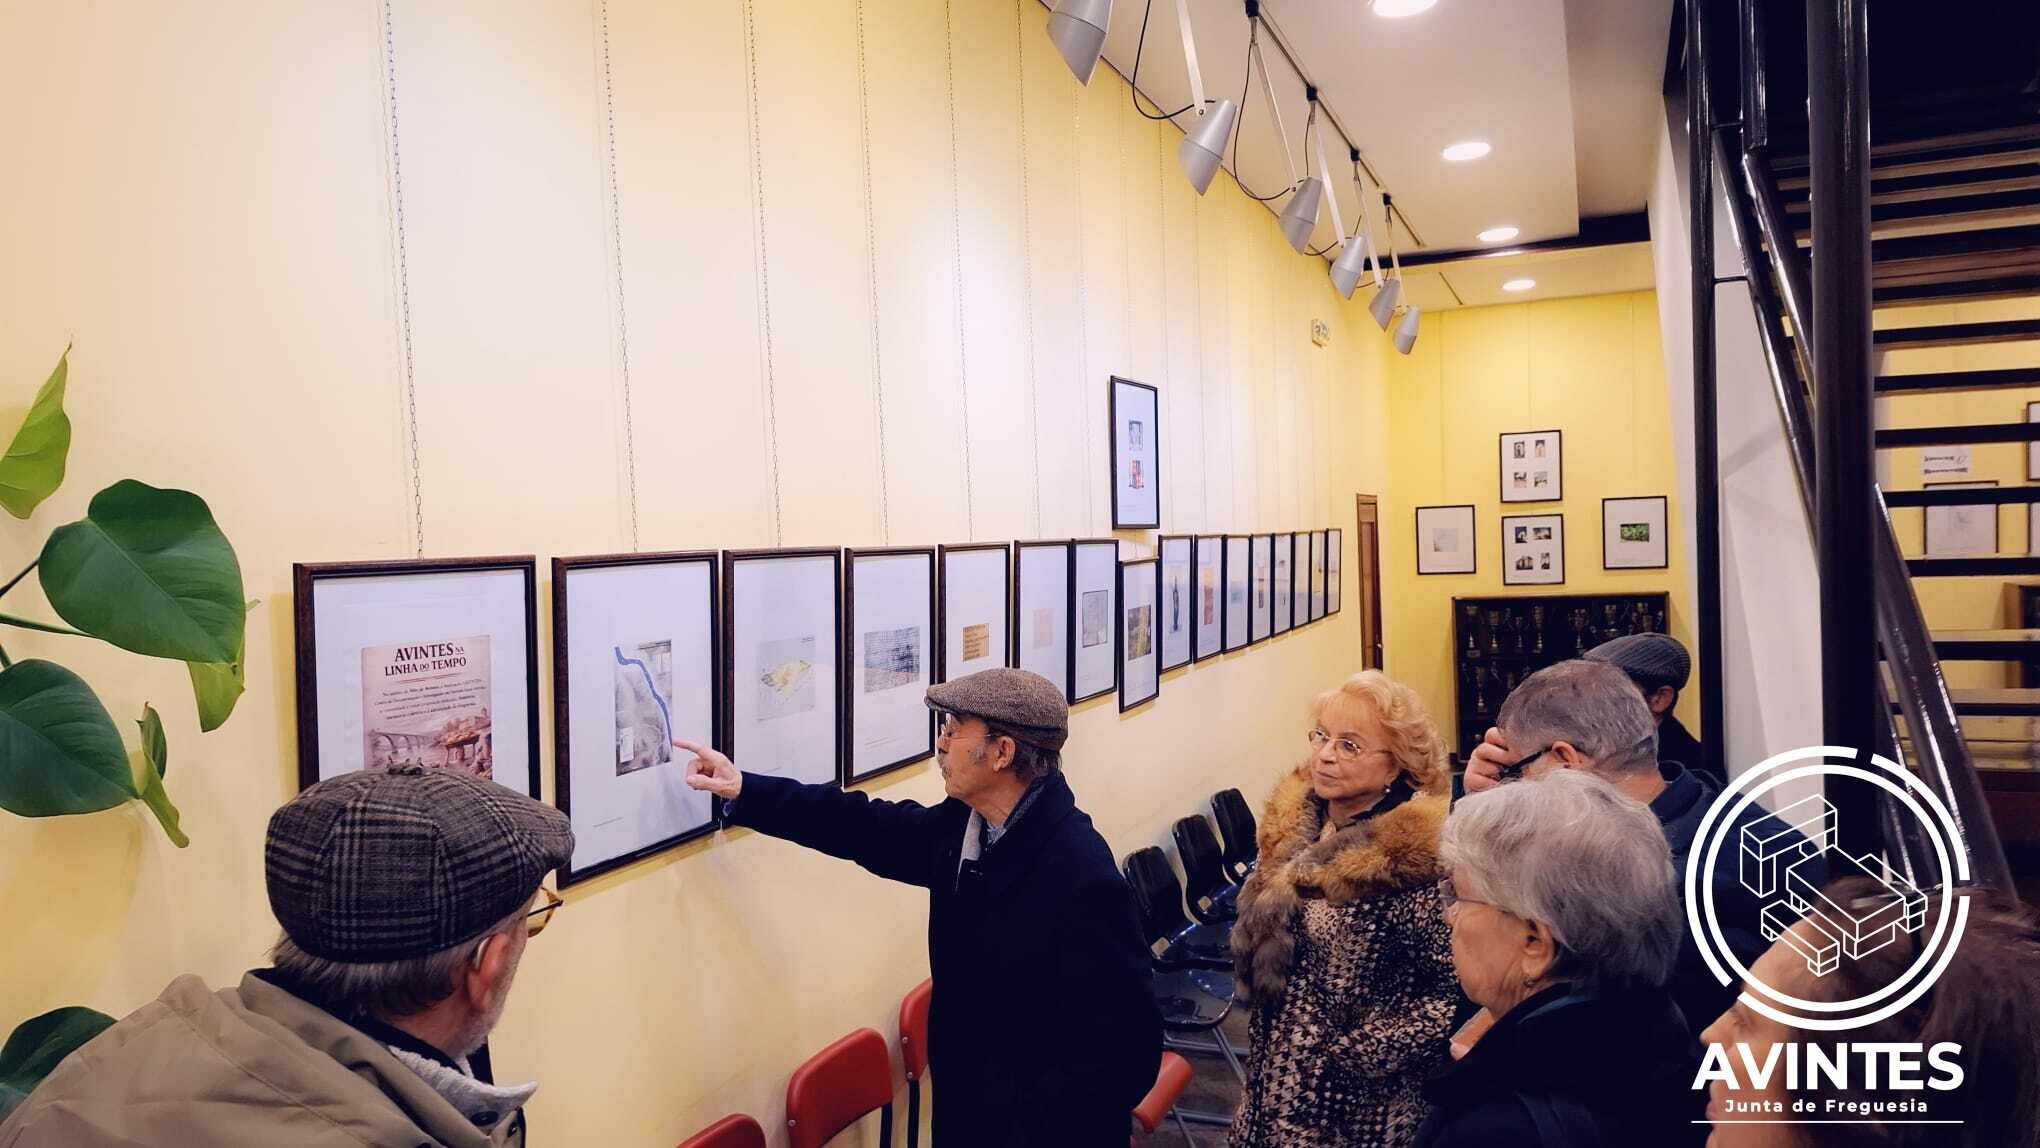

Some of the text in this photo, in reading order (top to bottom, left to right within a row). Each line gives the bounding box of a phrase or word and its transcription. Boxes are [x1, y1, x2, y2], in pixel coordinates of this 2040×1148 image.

[394, 642, 454, 662] AVINTES
[384, 656, 467, 677] LINHA DO TEMPO
